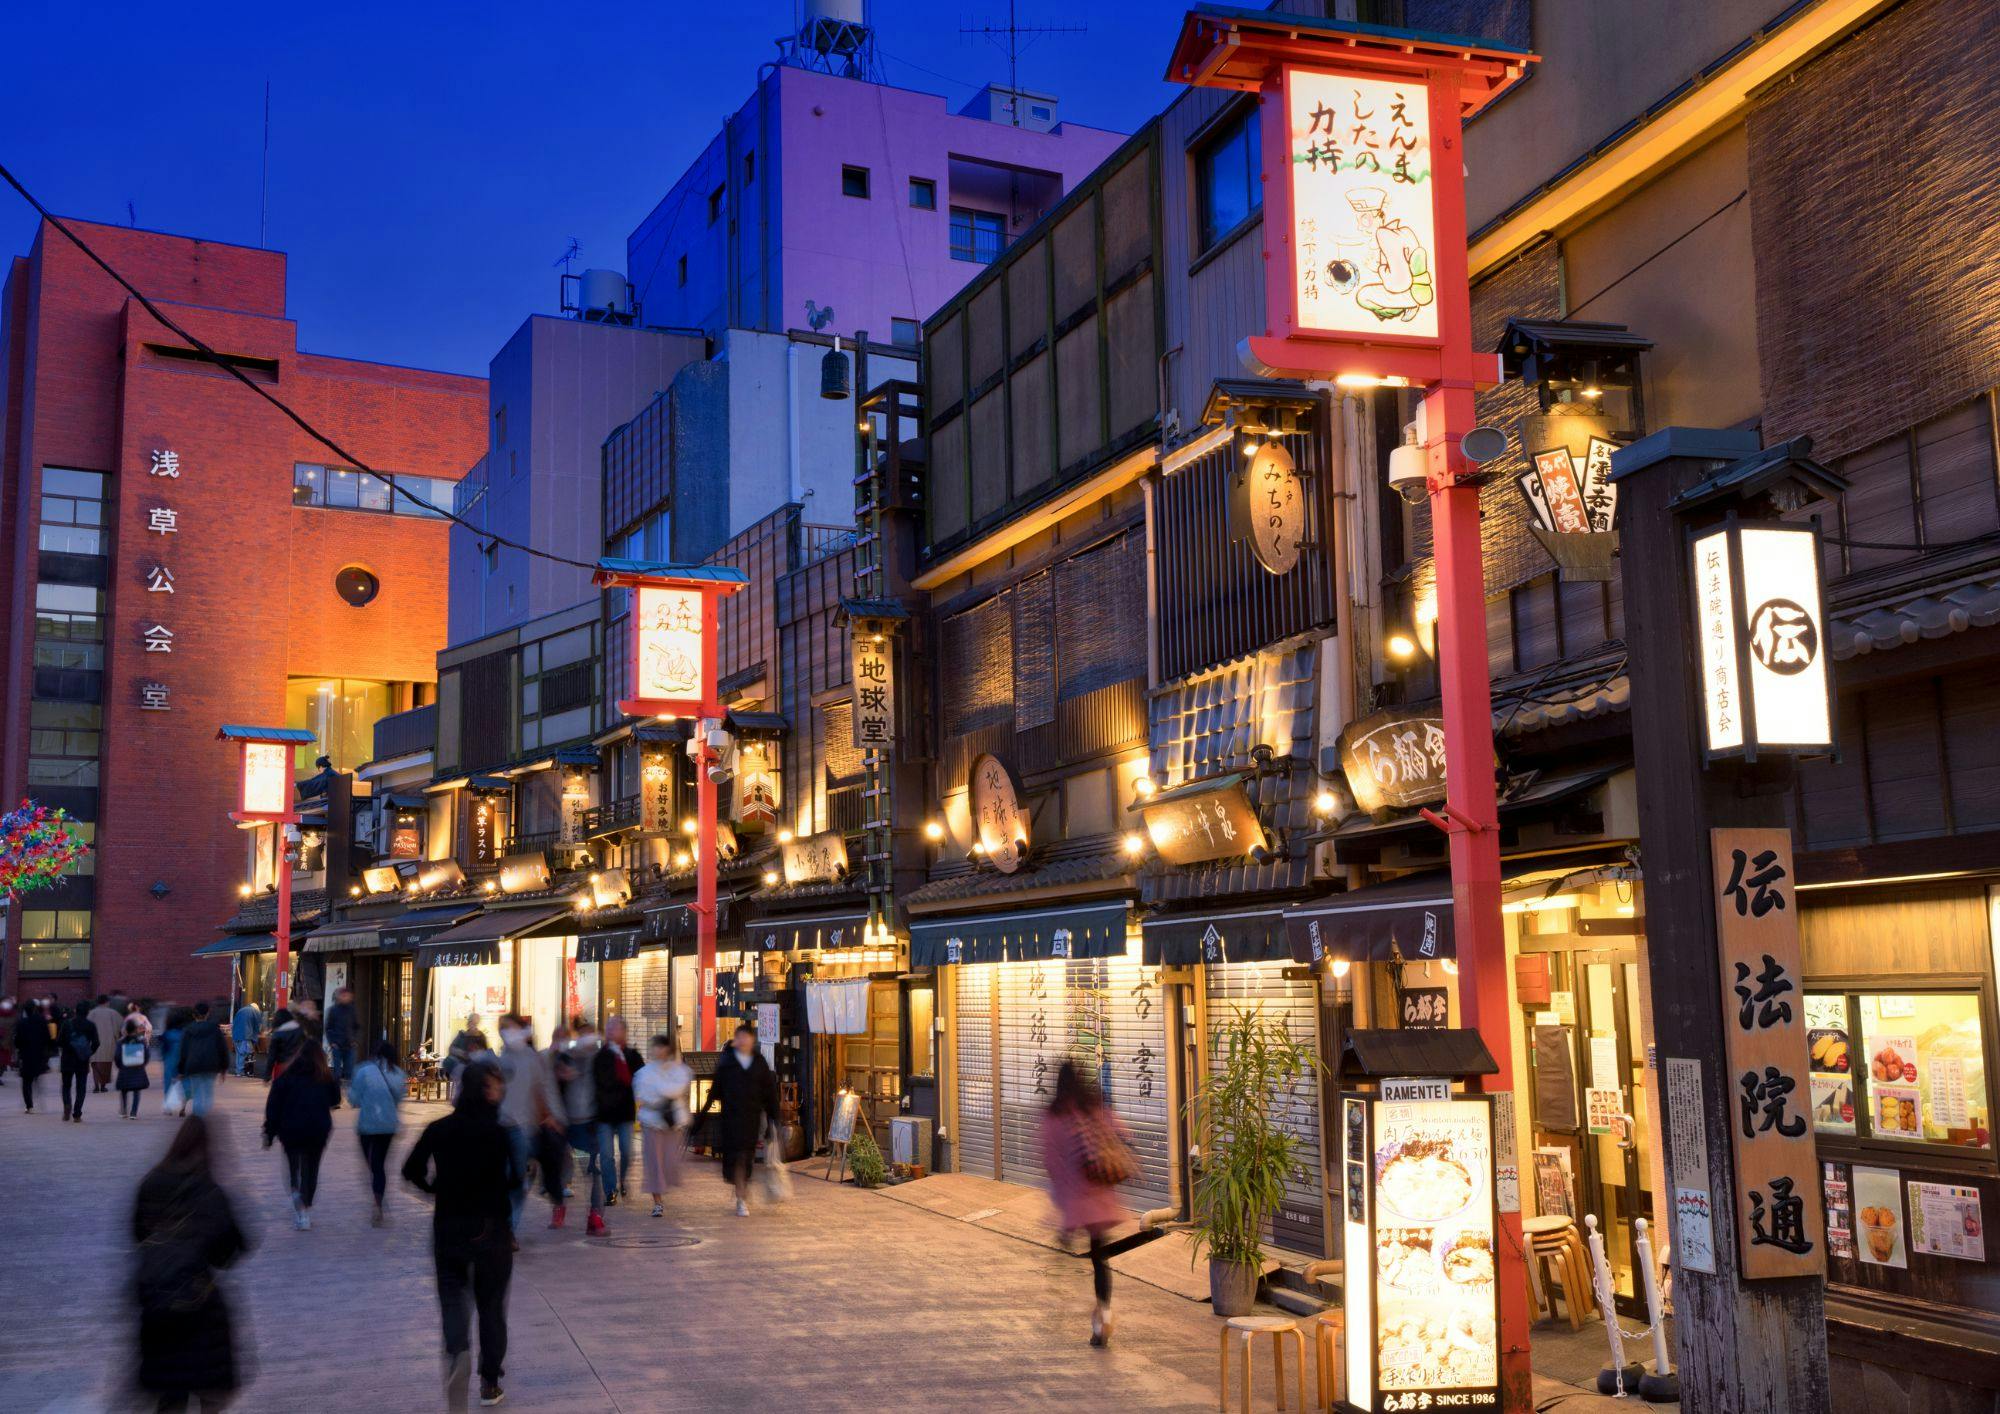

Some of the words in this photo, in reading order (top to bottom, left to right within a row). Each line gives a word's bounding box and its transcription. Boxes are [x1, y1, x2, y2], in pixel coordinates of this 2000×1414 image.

[1305, 100, 1344, 175] 力持
[1352, 89, 1380, 172] したの
[1389, 92, 1417, 184] えんま
[1264, 463, 1283, 556] みちのく
[141, 449, 180, 711] 浅草公会堂
[1707, 551, 1731, 733] 伝法院通り商店会
[1753, 606, 1811, 666] 伝
[859, 657, 888, 742] 地球堂
[476, 805, 488, 859] 浅草ラスク
[657, 783, 668, 829] お好み焼
[434, 952, 479, 967] 浅草ラスク
[1723, 849, 1814, 1255] 伝法院通
[1385, 1085, 1448, 1101] RAMENTEI
[1436, 1394, 1470, 1405] SINCE
[1471, 1393, 1496, 1404] 1986
